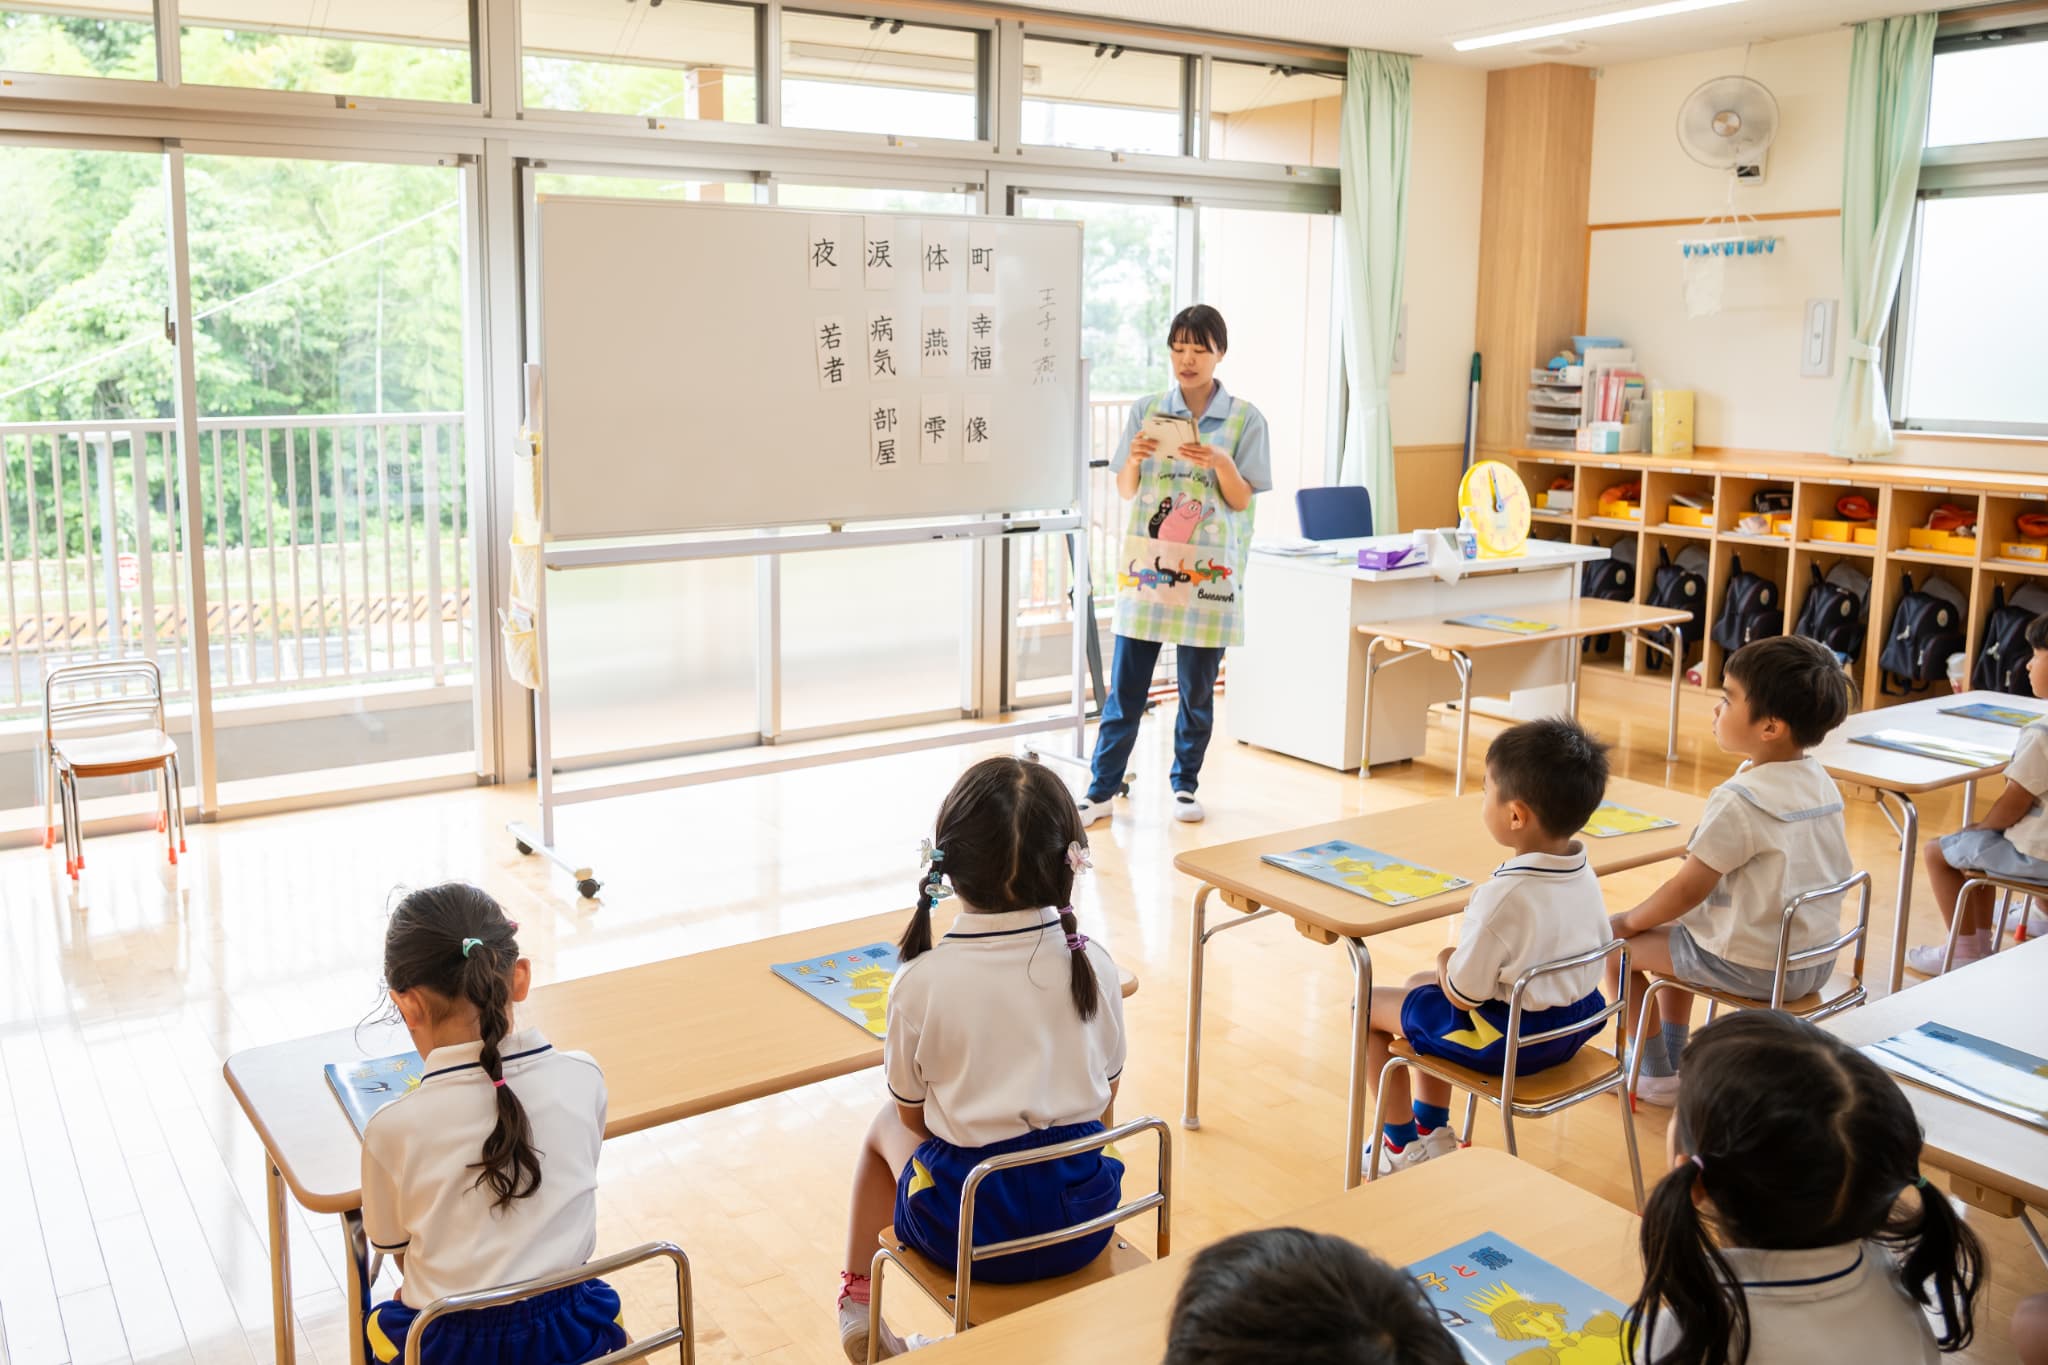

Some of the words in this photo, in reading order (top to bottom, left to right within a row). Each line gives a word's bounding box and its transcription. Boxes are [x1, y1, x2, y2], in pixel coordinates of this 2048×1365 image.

[812, 238, 838, 268] 夜
[867, 240, 893, 268] 涙
[925, 243, 950, 272] 体
[971, 247, 993, 273] 町
[820, 322, 846, 384] 若者
[870, 314, 897, 376] 病気
[924, 327, 949, 357] 燕
[971, 312, 993, 371] 幸福
[873, 407, 898, 466] 部屋
[924, 415, 948, 444] 雫
[966, 416, 990, 444] 像
